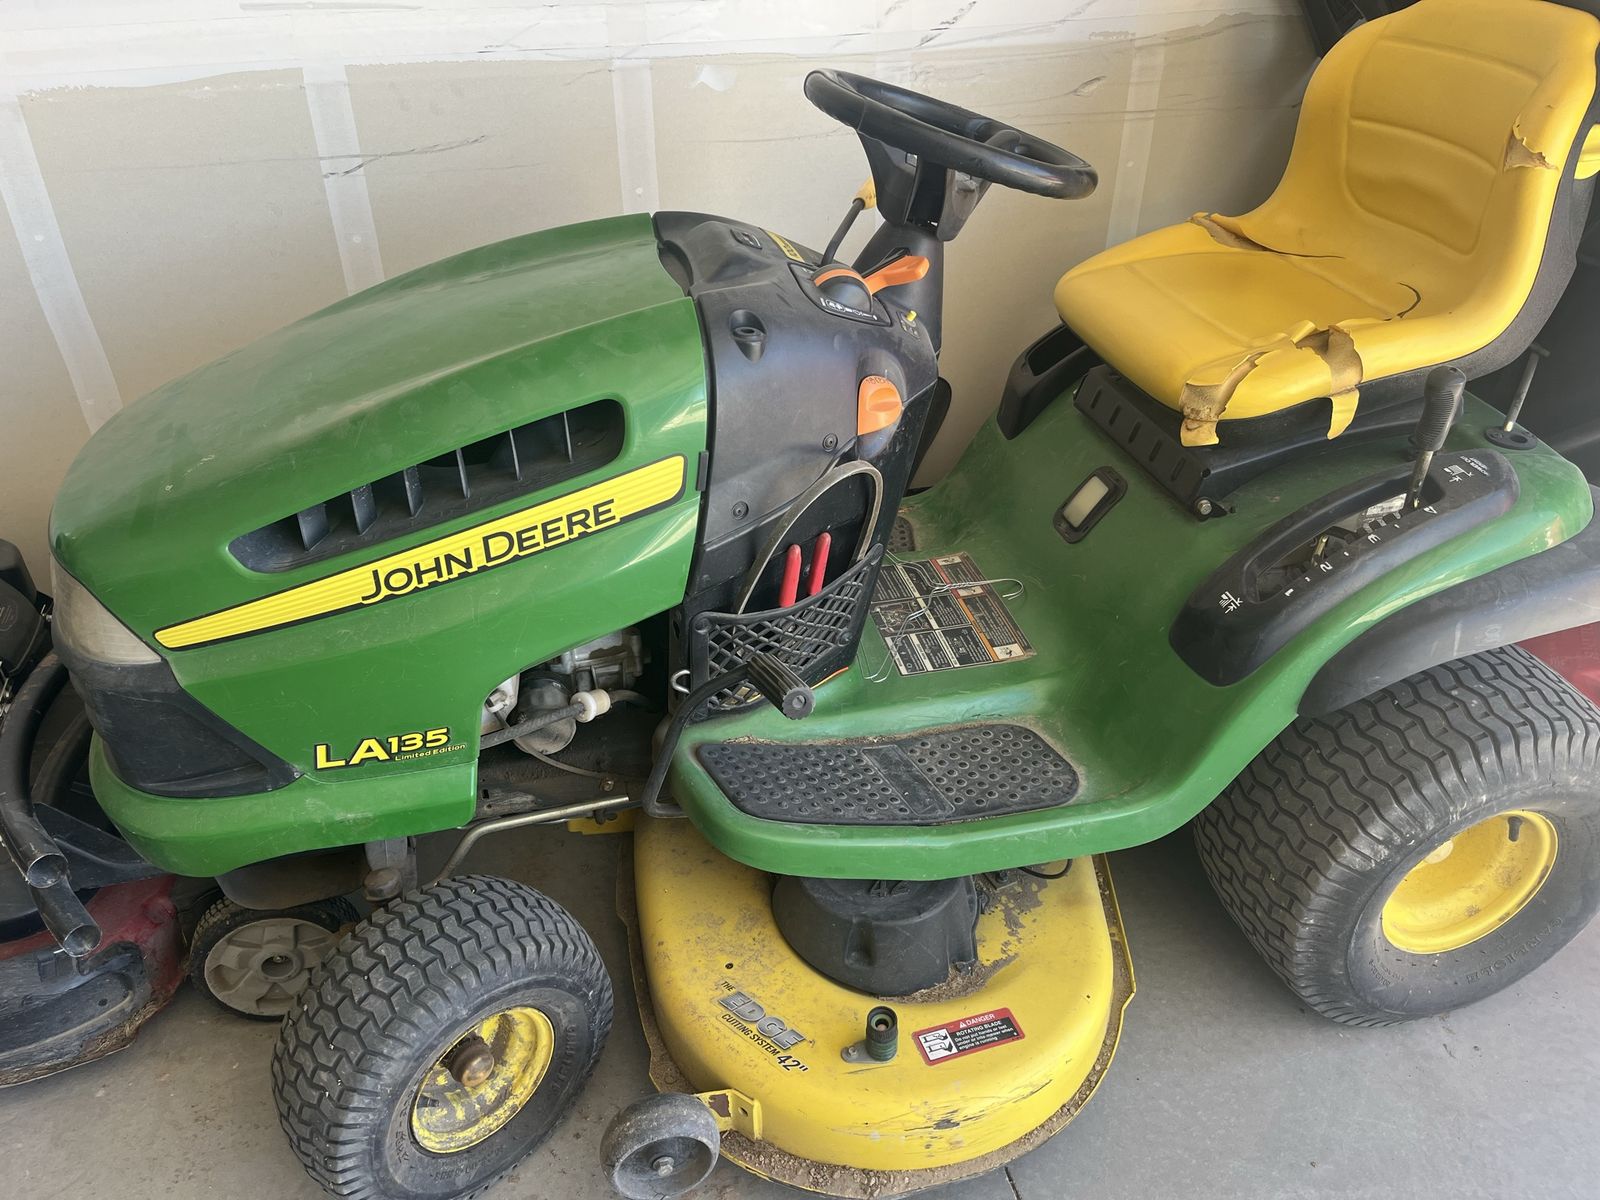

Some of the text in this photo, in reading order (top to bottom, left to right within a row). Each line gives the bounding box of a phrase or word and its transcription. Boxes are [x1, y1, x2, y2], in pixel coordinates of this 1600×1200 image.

[1367, 534, 1381, 544] 3
[361, 498, 616, 601] JOHN DEERE
[1320, 561, 1332, 572] 2
[1284, 588, 1294, 597] 1
[395, 744, 466, 761] Limited Edition
[721, 981, 736, 992] THE
[718, 991, 806, 1051] EDGE
[966, 1014, 996, 1026] DANGER
[956, 1020, 1002, 1036] ROTATING BLADE
[722, 1013, 808, 1072] CUTTING SYSTEM 42"
